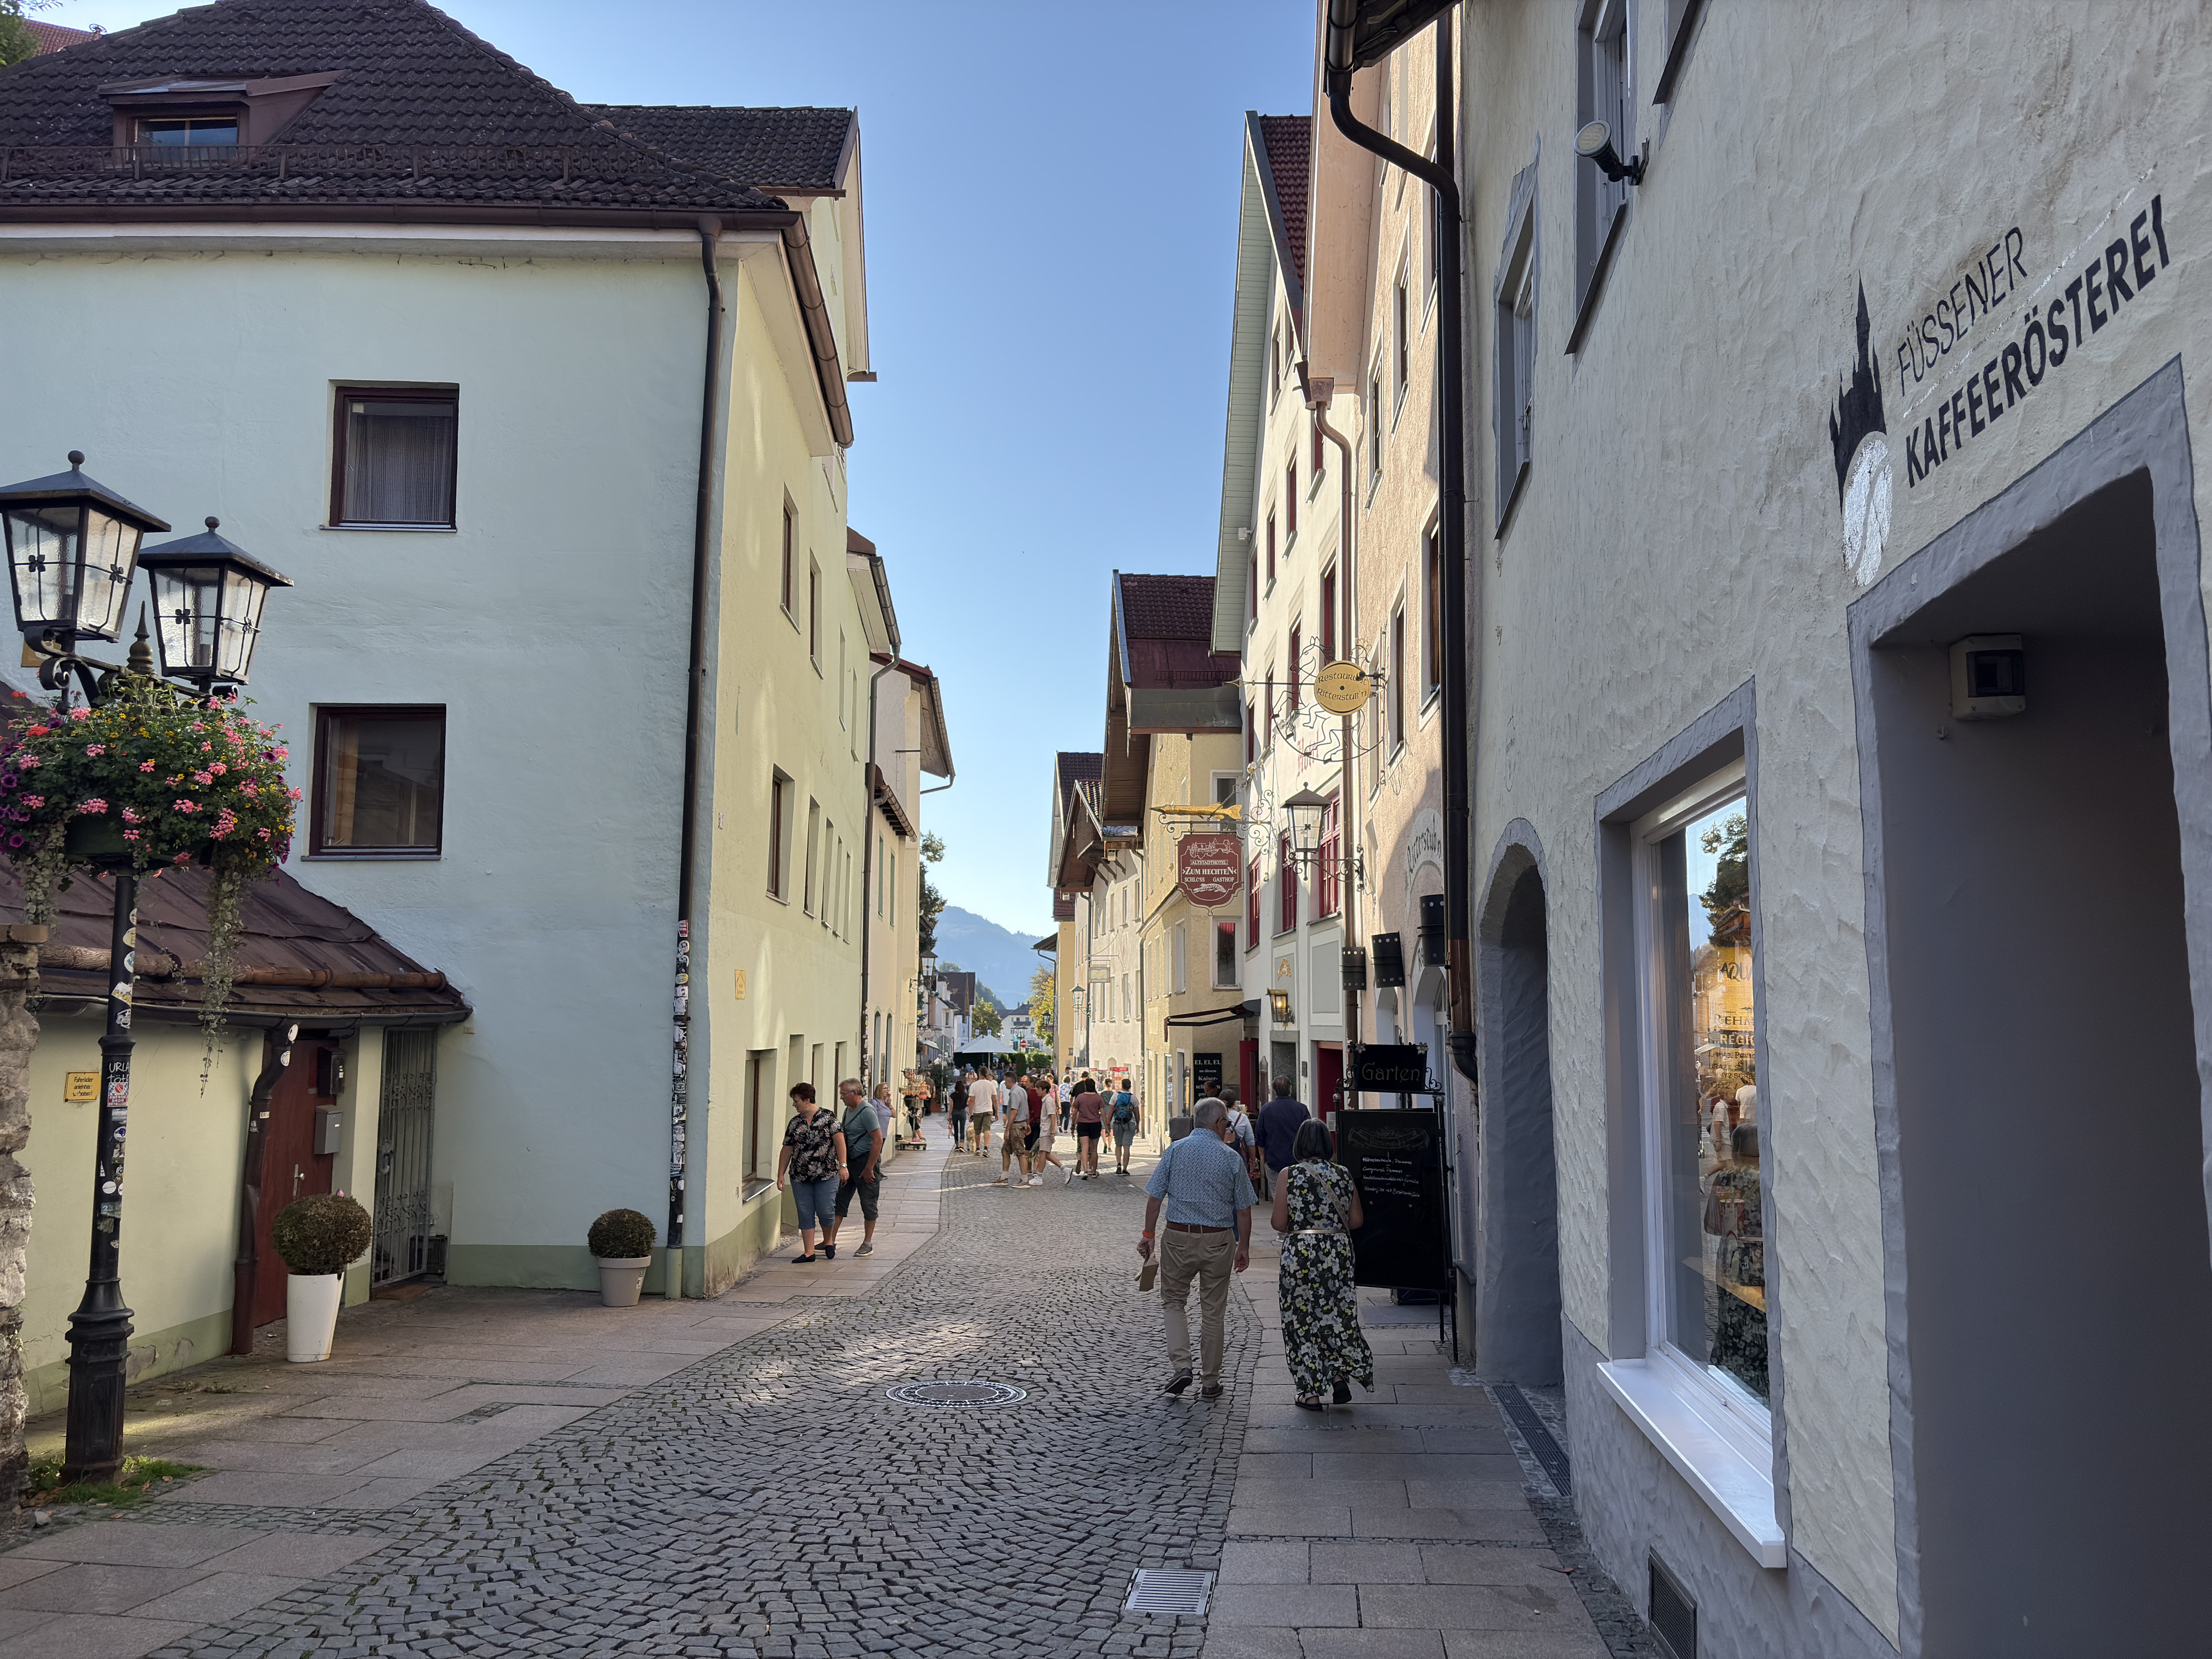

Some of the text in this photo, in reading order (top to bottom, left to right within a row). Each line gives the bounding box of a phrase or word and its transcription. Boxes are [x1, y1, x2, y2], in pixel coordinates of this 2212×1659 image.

[1897, 226, 2028, 397] FÜSSENER
[1906, 194, 2170, 488] KAFFEERÖSTEREI
[1361, 1062, 1420, 1082] Garten
